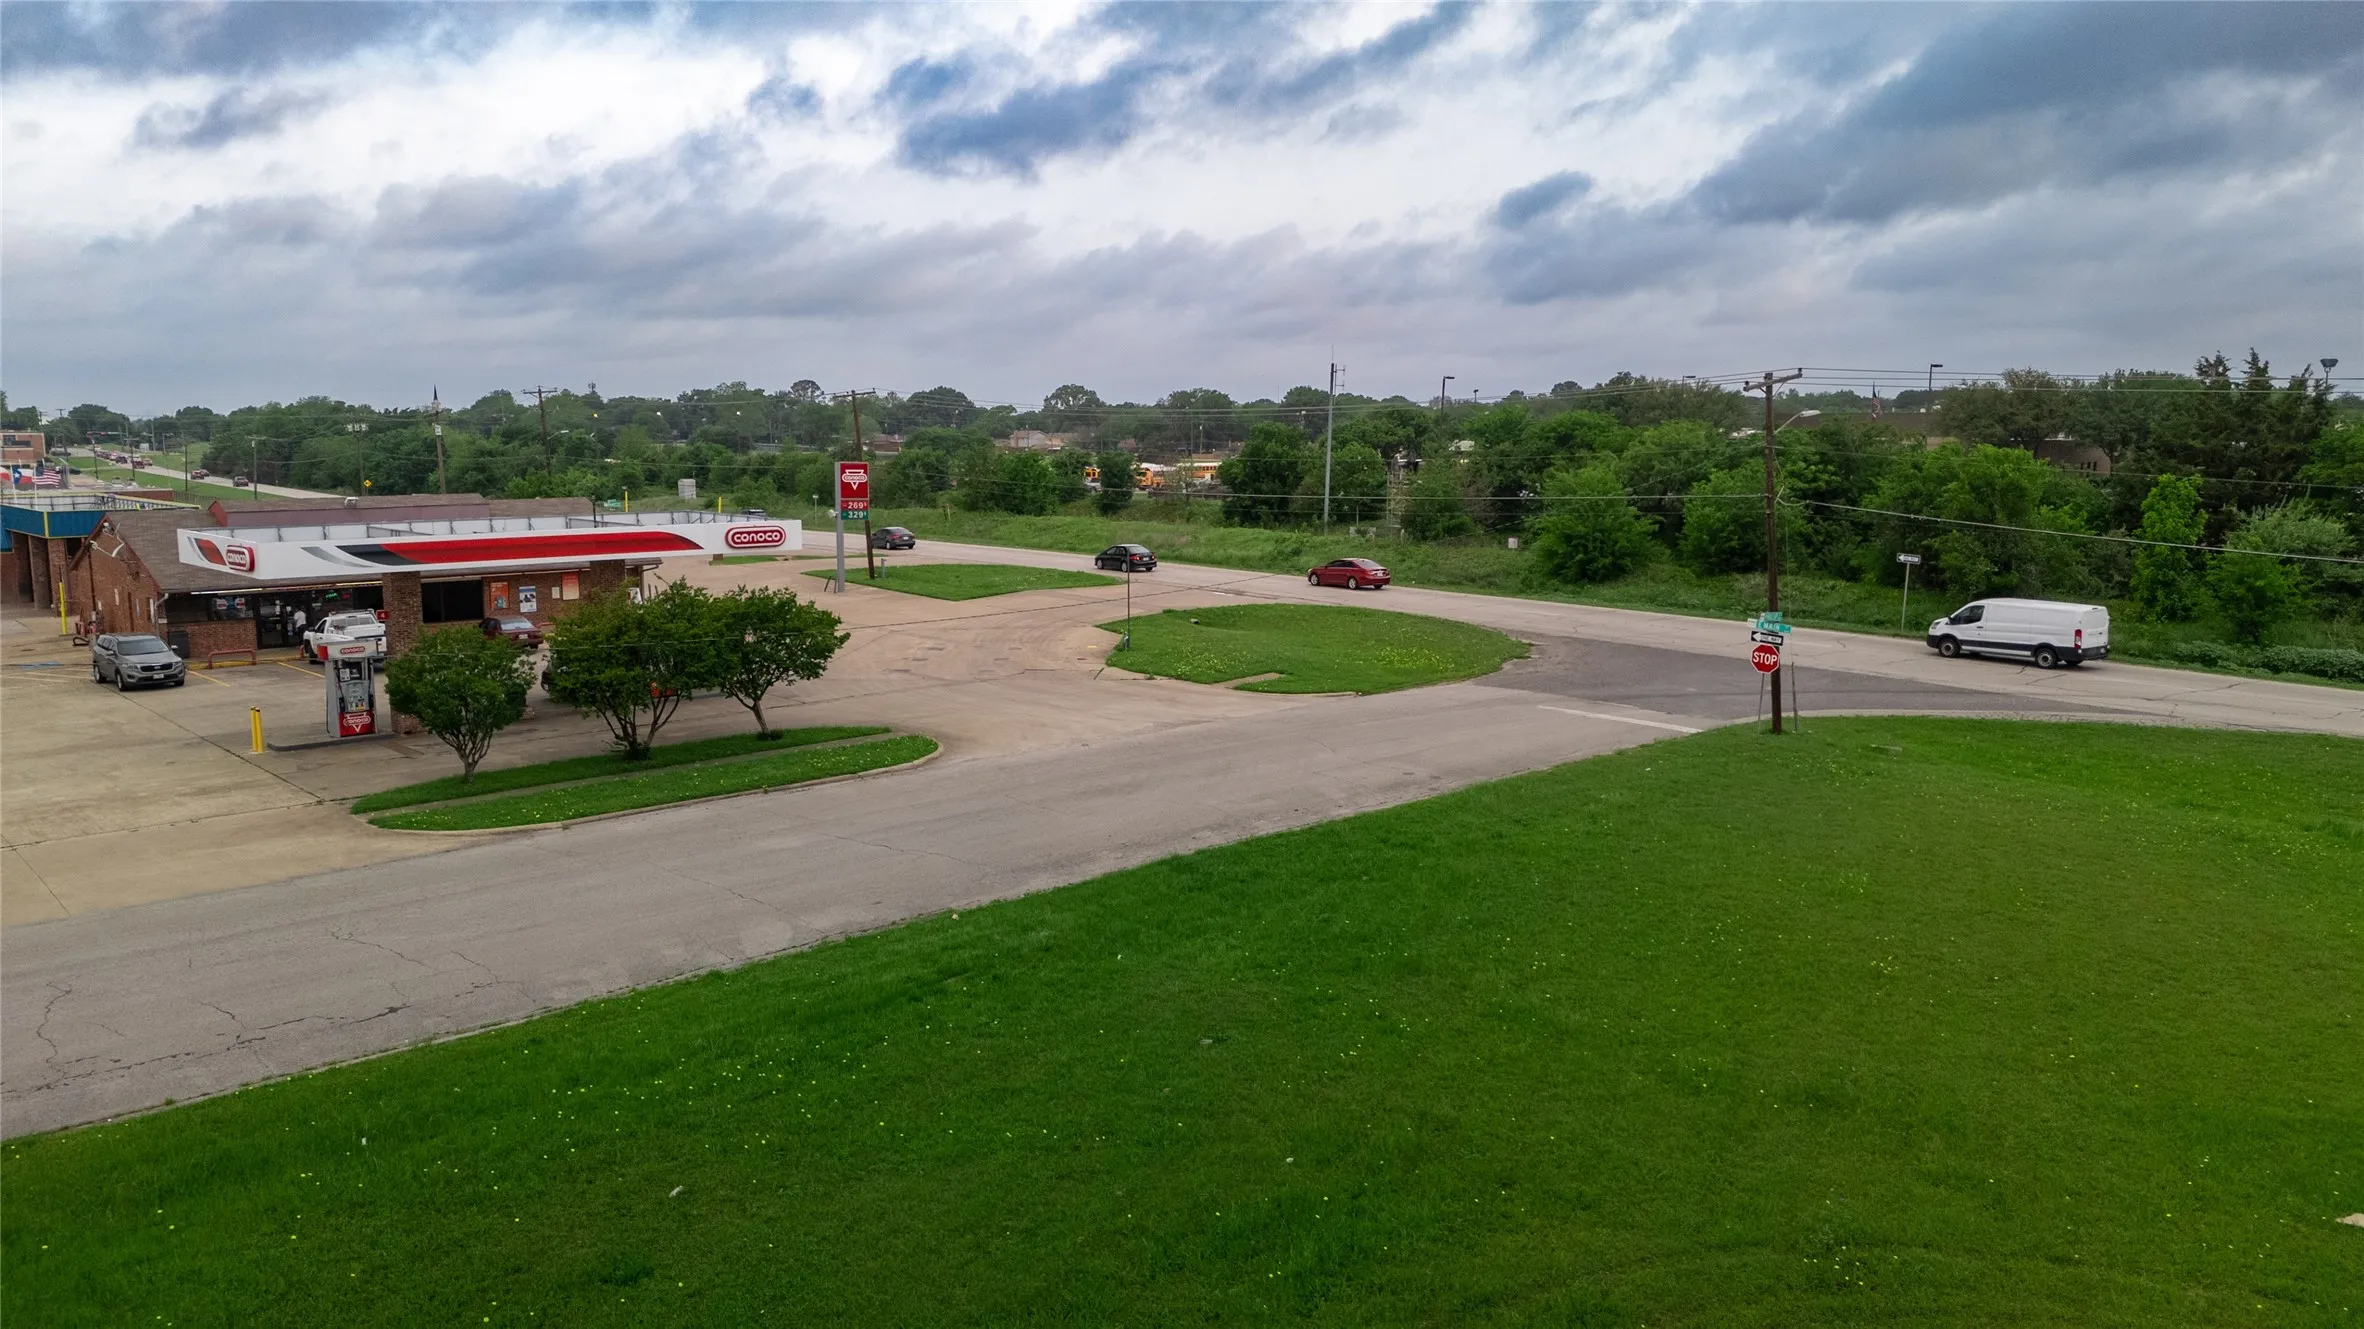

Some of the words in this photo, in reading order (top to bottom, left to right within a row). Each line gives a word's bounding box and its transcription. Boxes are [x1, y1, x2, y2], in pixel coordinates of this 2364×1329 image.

[734, 532, 780, 542] conoco
[1763, 622, 1780, 631] MAIN
[1753, 652, 1777, 665] STOP
